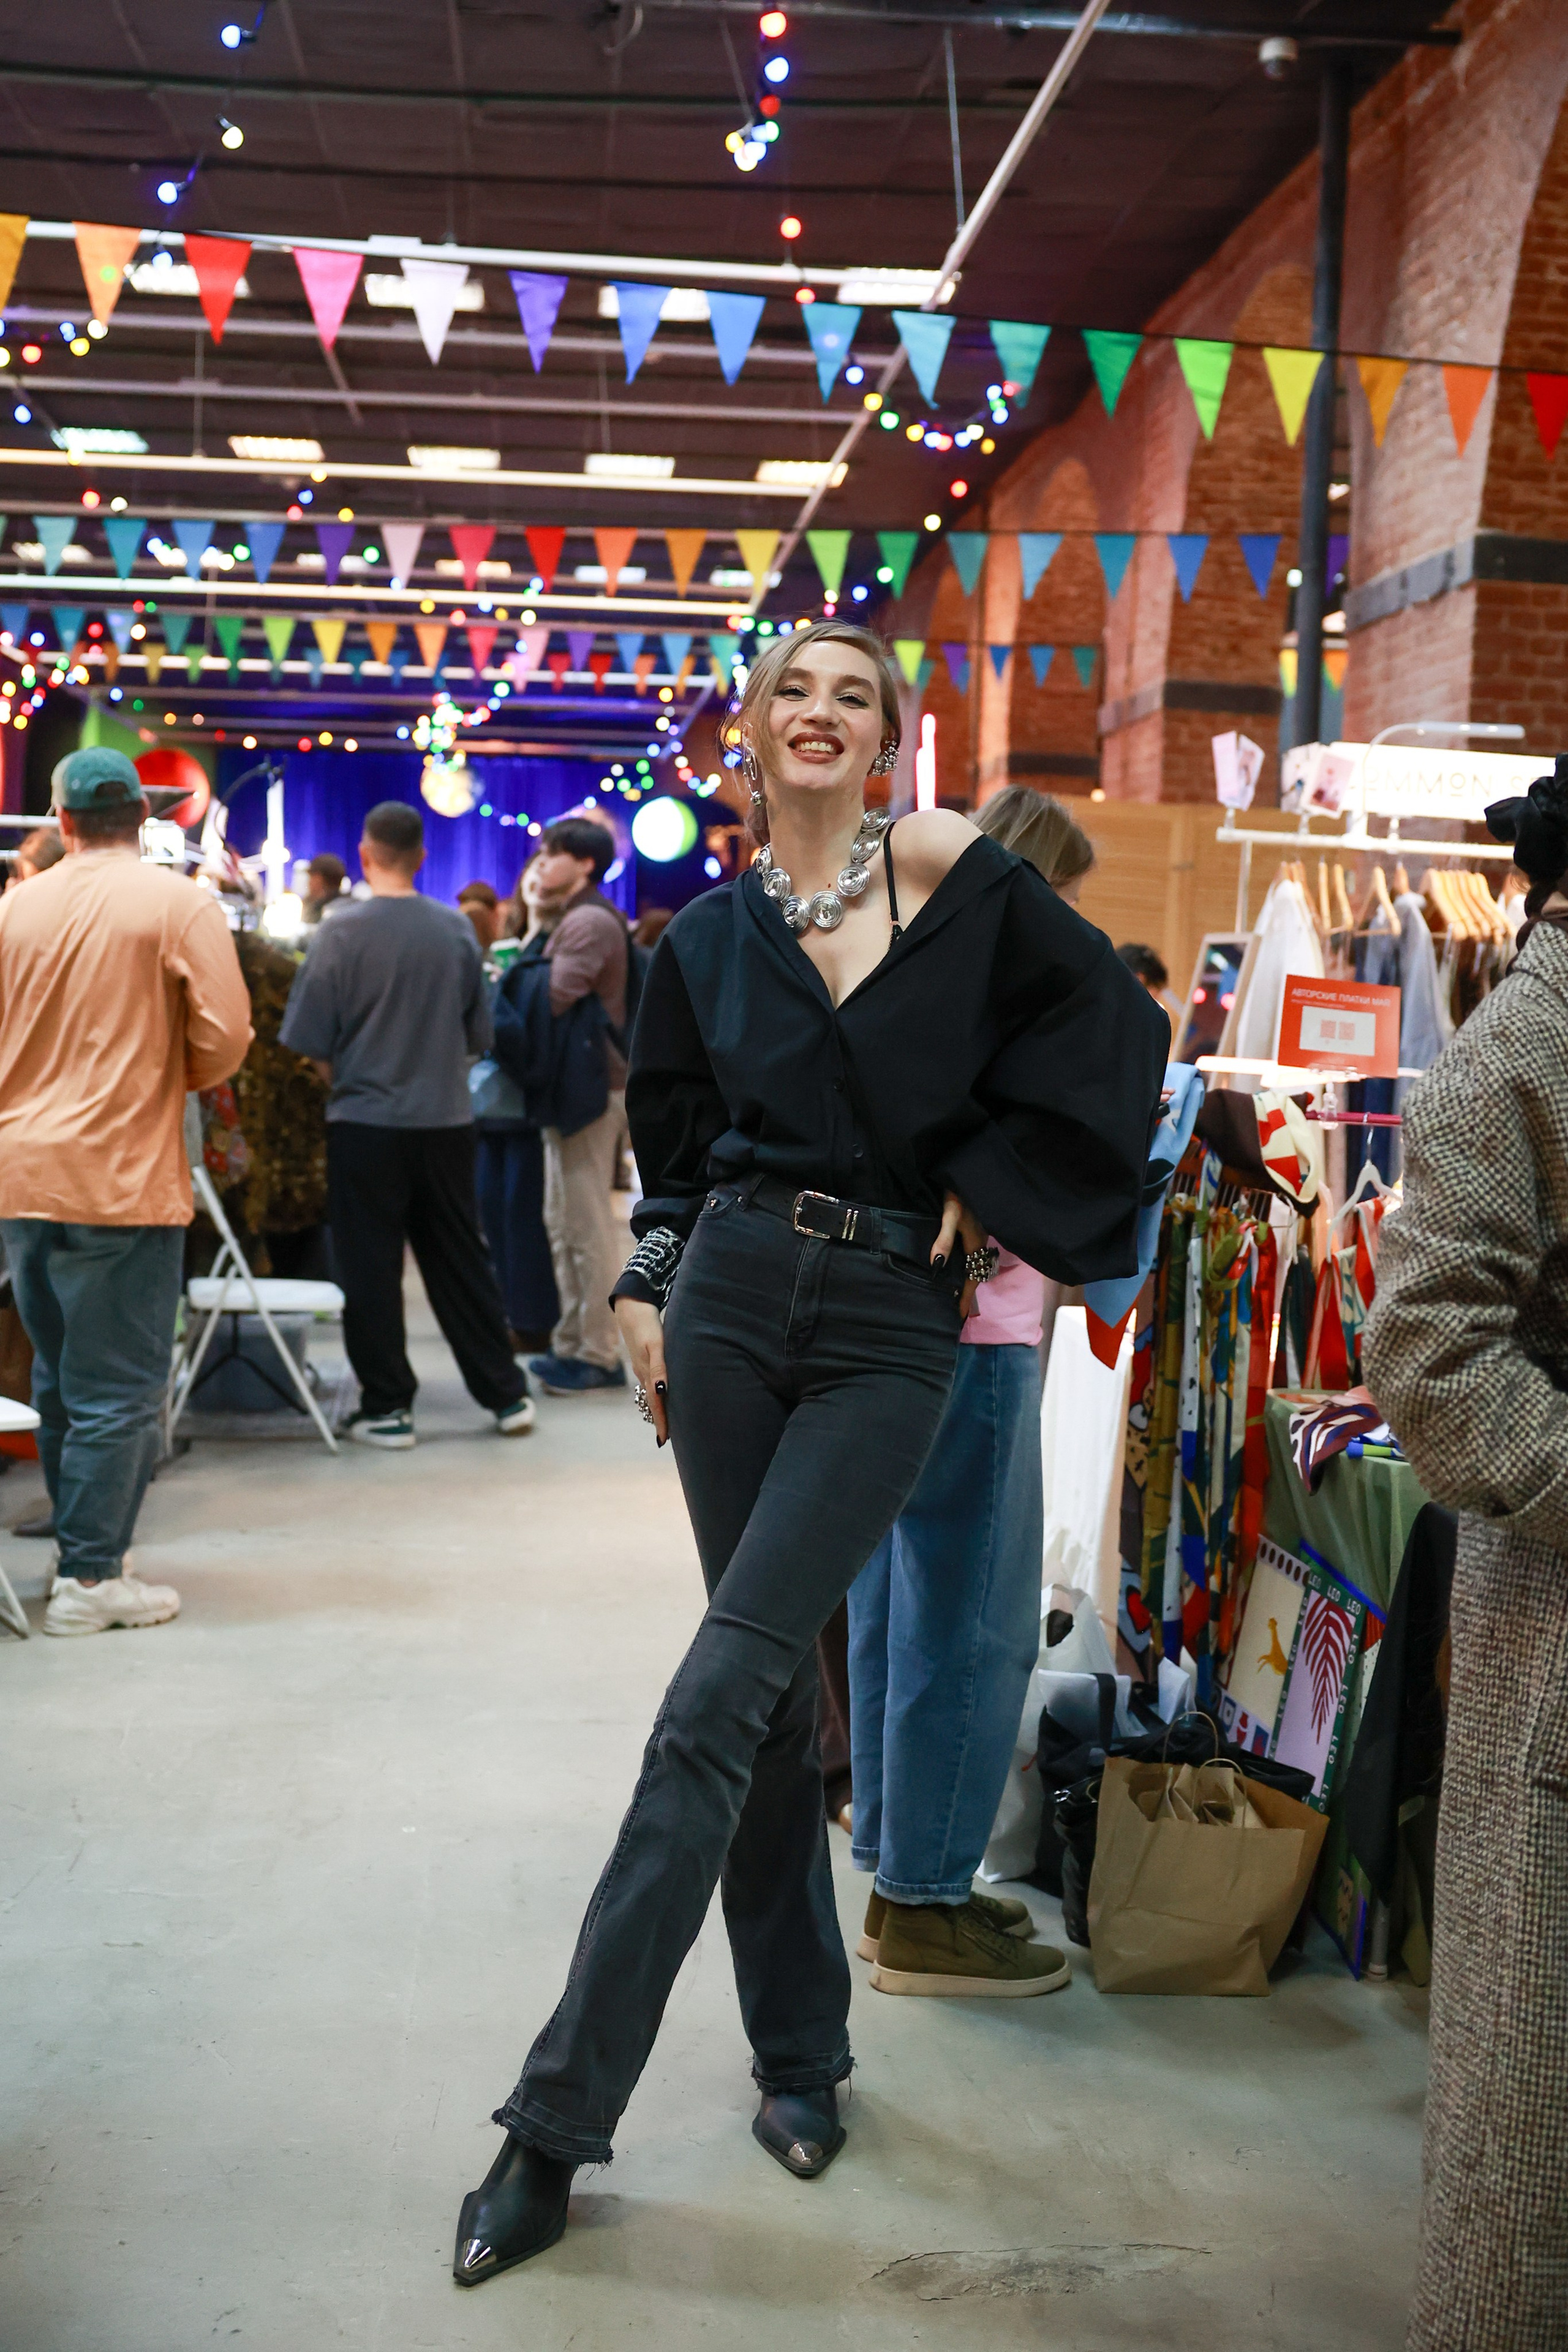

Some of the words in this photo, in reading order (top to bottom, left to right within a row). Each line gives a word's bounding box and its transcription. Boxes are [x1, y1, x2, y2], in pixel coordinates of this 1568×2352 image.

[1349, 764, 1493, 798] OMMON
[1308, 1573, 1322, 1589] LEO
[1327, 1585, 1341, 1602] LEO
[1347, 1598, 1362, 1615] LEO
[1348, 1634, 1359, 1665] LEO
[1338, 1684, 1349, 1714] LEO
[1329, 1735, 1339, 1765] LEO
